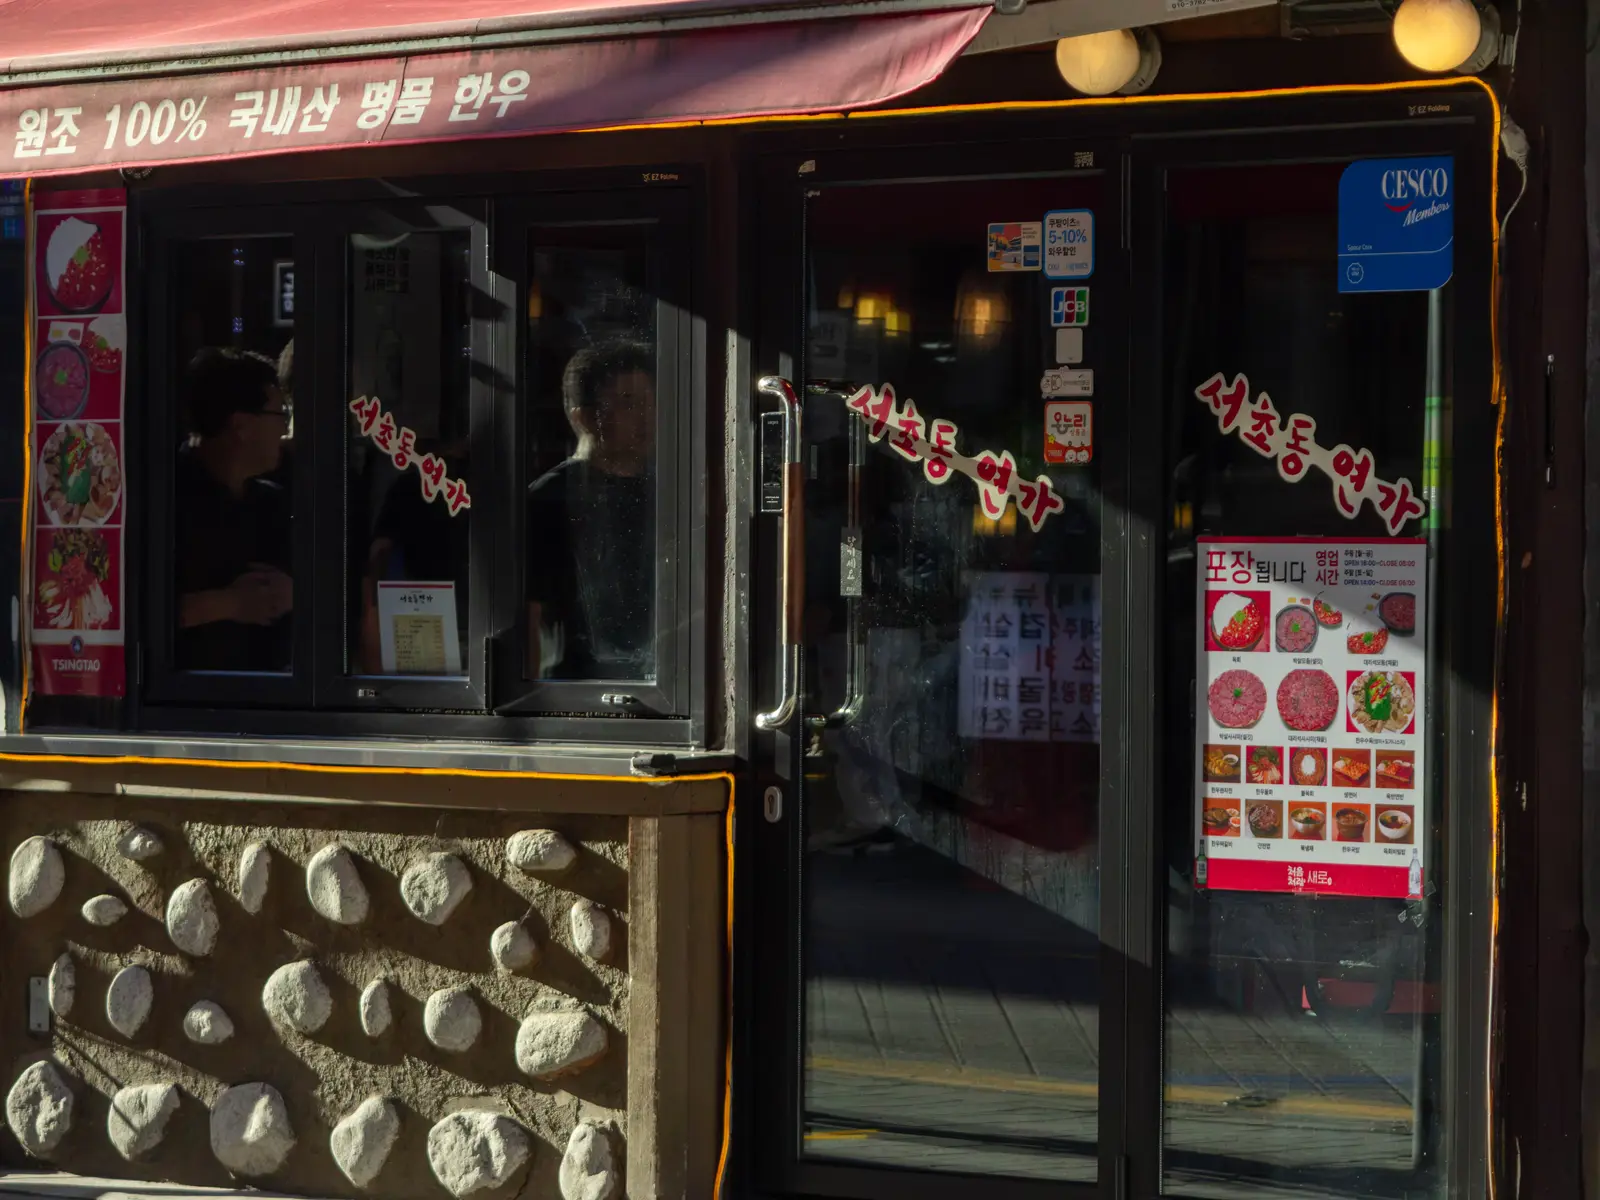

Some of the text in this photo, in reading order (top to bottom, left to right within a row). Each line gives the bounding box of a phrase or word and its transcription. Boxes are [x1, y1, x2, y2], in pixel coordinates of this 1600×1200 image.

[13, 69, 531, 159] 원조 100% 국내산 명품 한우
[1381, 167, 1448, 200] CESCO
[1402, 199, 1451, 228] Members
[1049, 229, 1087, 244] 5-10%
[1053, 301, 1085, 312] JCB
[349, 395, 471, 517] 서초동 연가
[846, 382, 1064, 532] 서초동 연가
[1194, 372, 1425, 536] 서초동 연가
[846, 535, 856, 580] 당기세요
[1205, 551, 1306, 584] 포장됩니다
[1316, 550, 1339, 567] 영업
[1316, 569, 1339, 585] 시간
[52, 659, 100, 672] TSINGTAO
[1287, 865, 1304, 877] 처음
